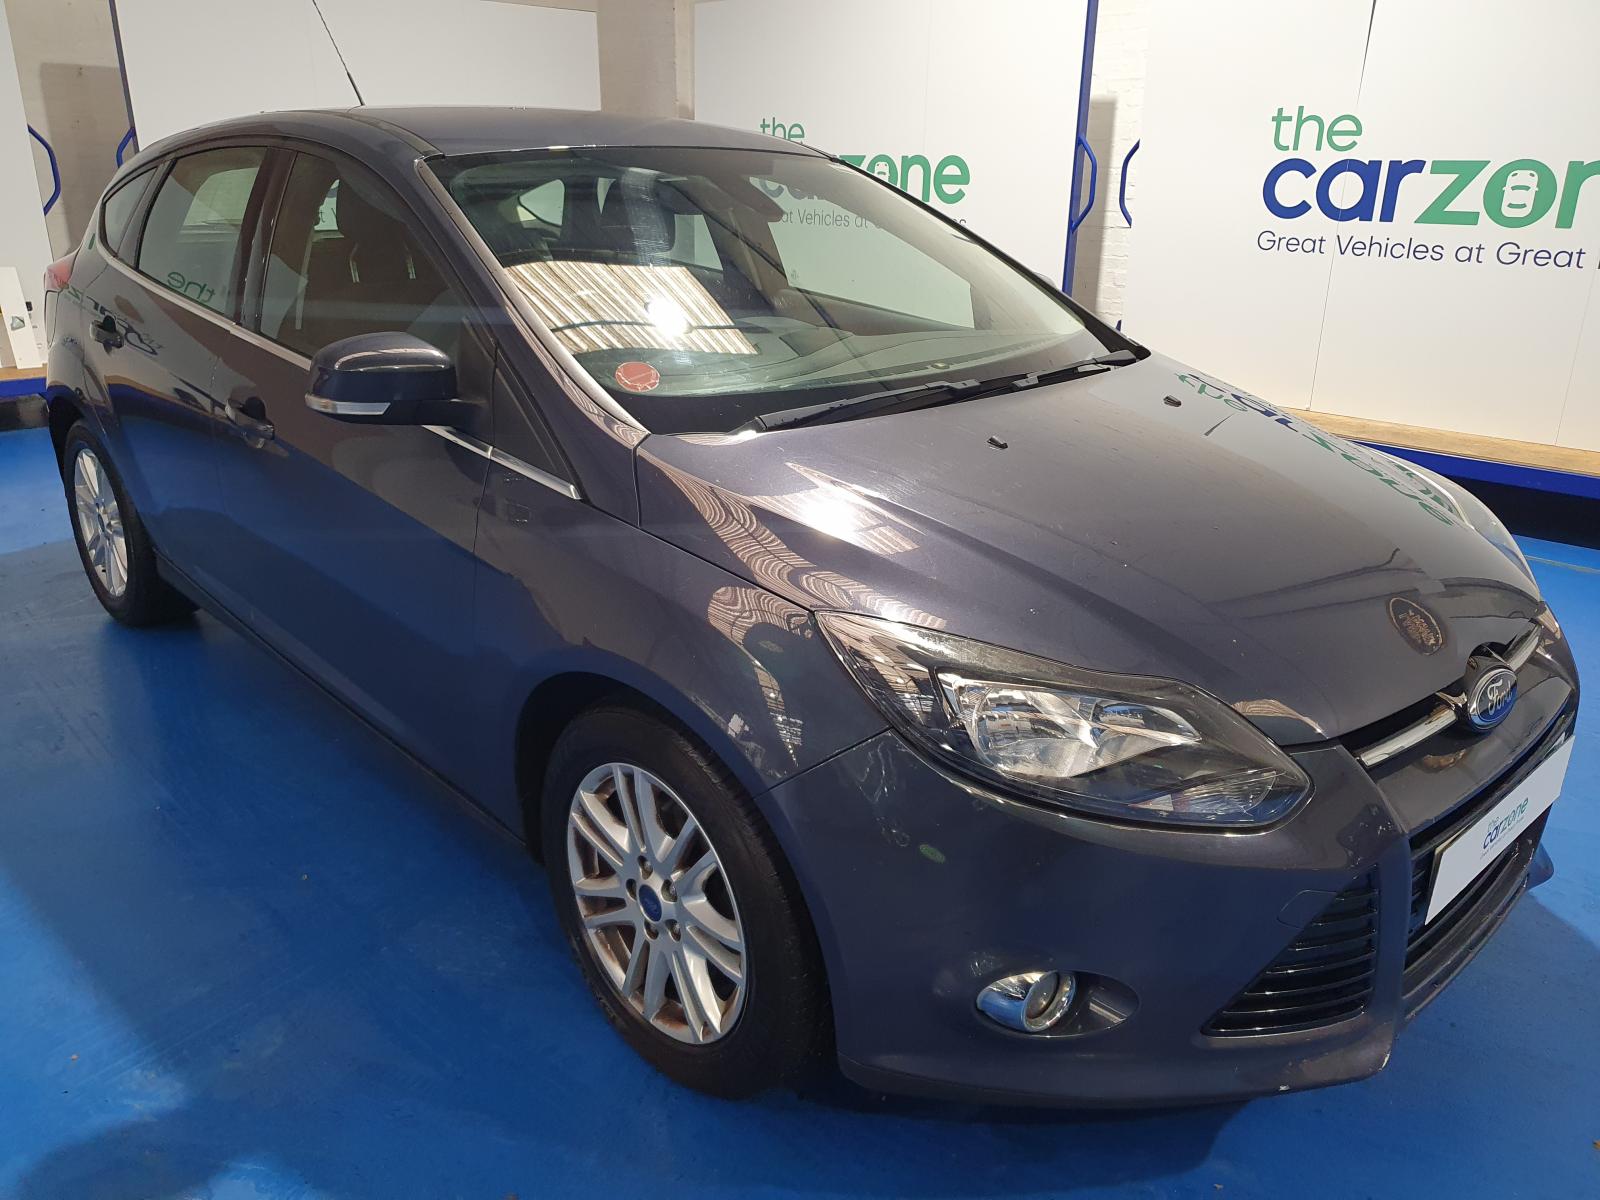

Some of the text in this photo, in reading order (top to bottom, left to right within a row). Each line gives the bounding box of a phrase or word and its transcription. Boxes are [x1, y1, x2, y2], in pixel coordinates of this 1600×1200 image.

[760, 117, 805, 141] the
[1271, 105, 1363, 152] the
[797, 208, 850, 228] Vehicles
[1257, 230, 1326, 254] Great
[1336, 234, 1445, 262] Vehicles
[1455, 243, 1485, 264] at
[1496, 241, 1586, 269] Great
[1487, 678, 1513, 716] Ford
[1483, 797, 1529, 850] carzone
